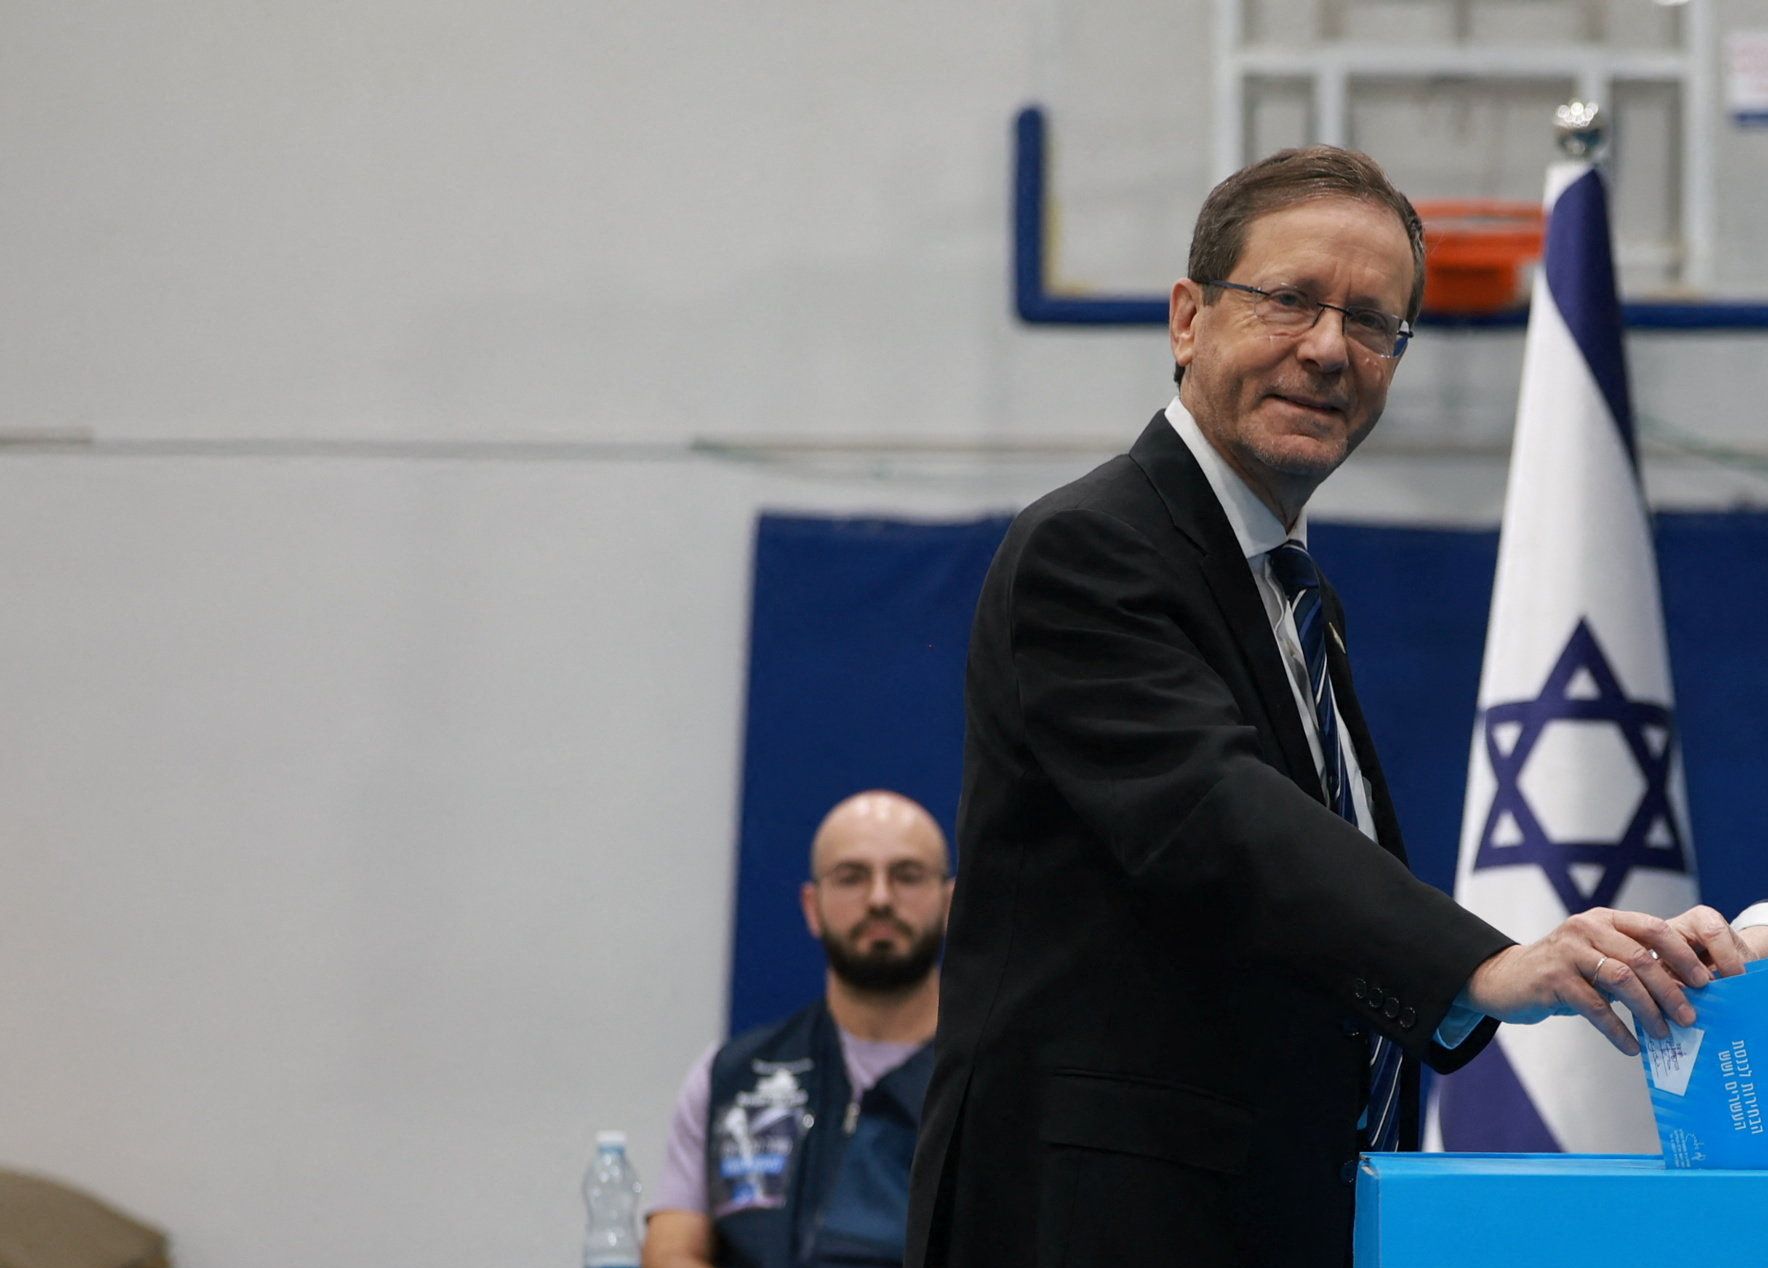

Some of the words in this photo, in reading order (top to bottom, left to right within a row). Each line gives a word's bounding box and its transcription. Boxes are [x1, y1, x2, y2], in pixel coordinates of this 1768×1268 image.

[1718, 1050, 1735, 1077] ושש
[1732, 1039, 1752, 1078] לכנסת
[1725, 1081, 1746, 1130] העשרים
[1741, 1081, 1763, 1134] הבחירות
